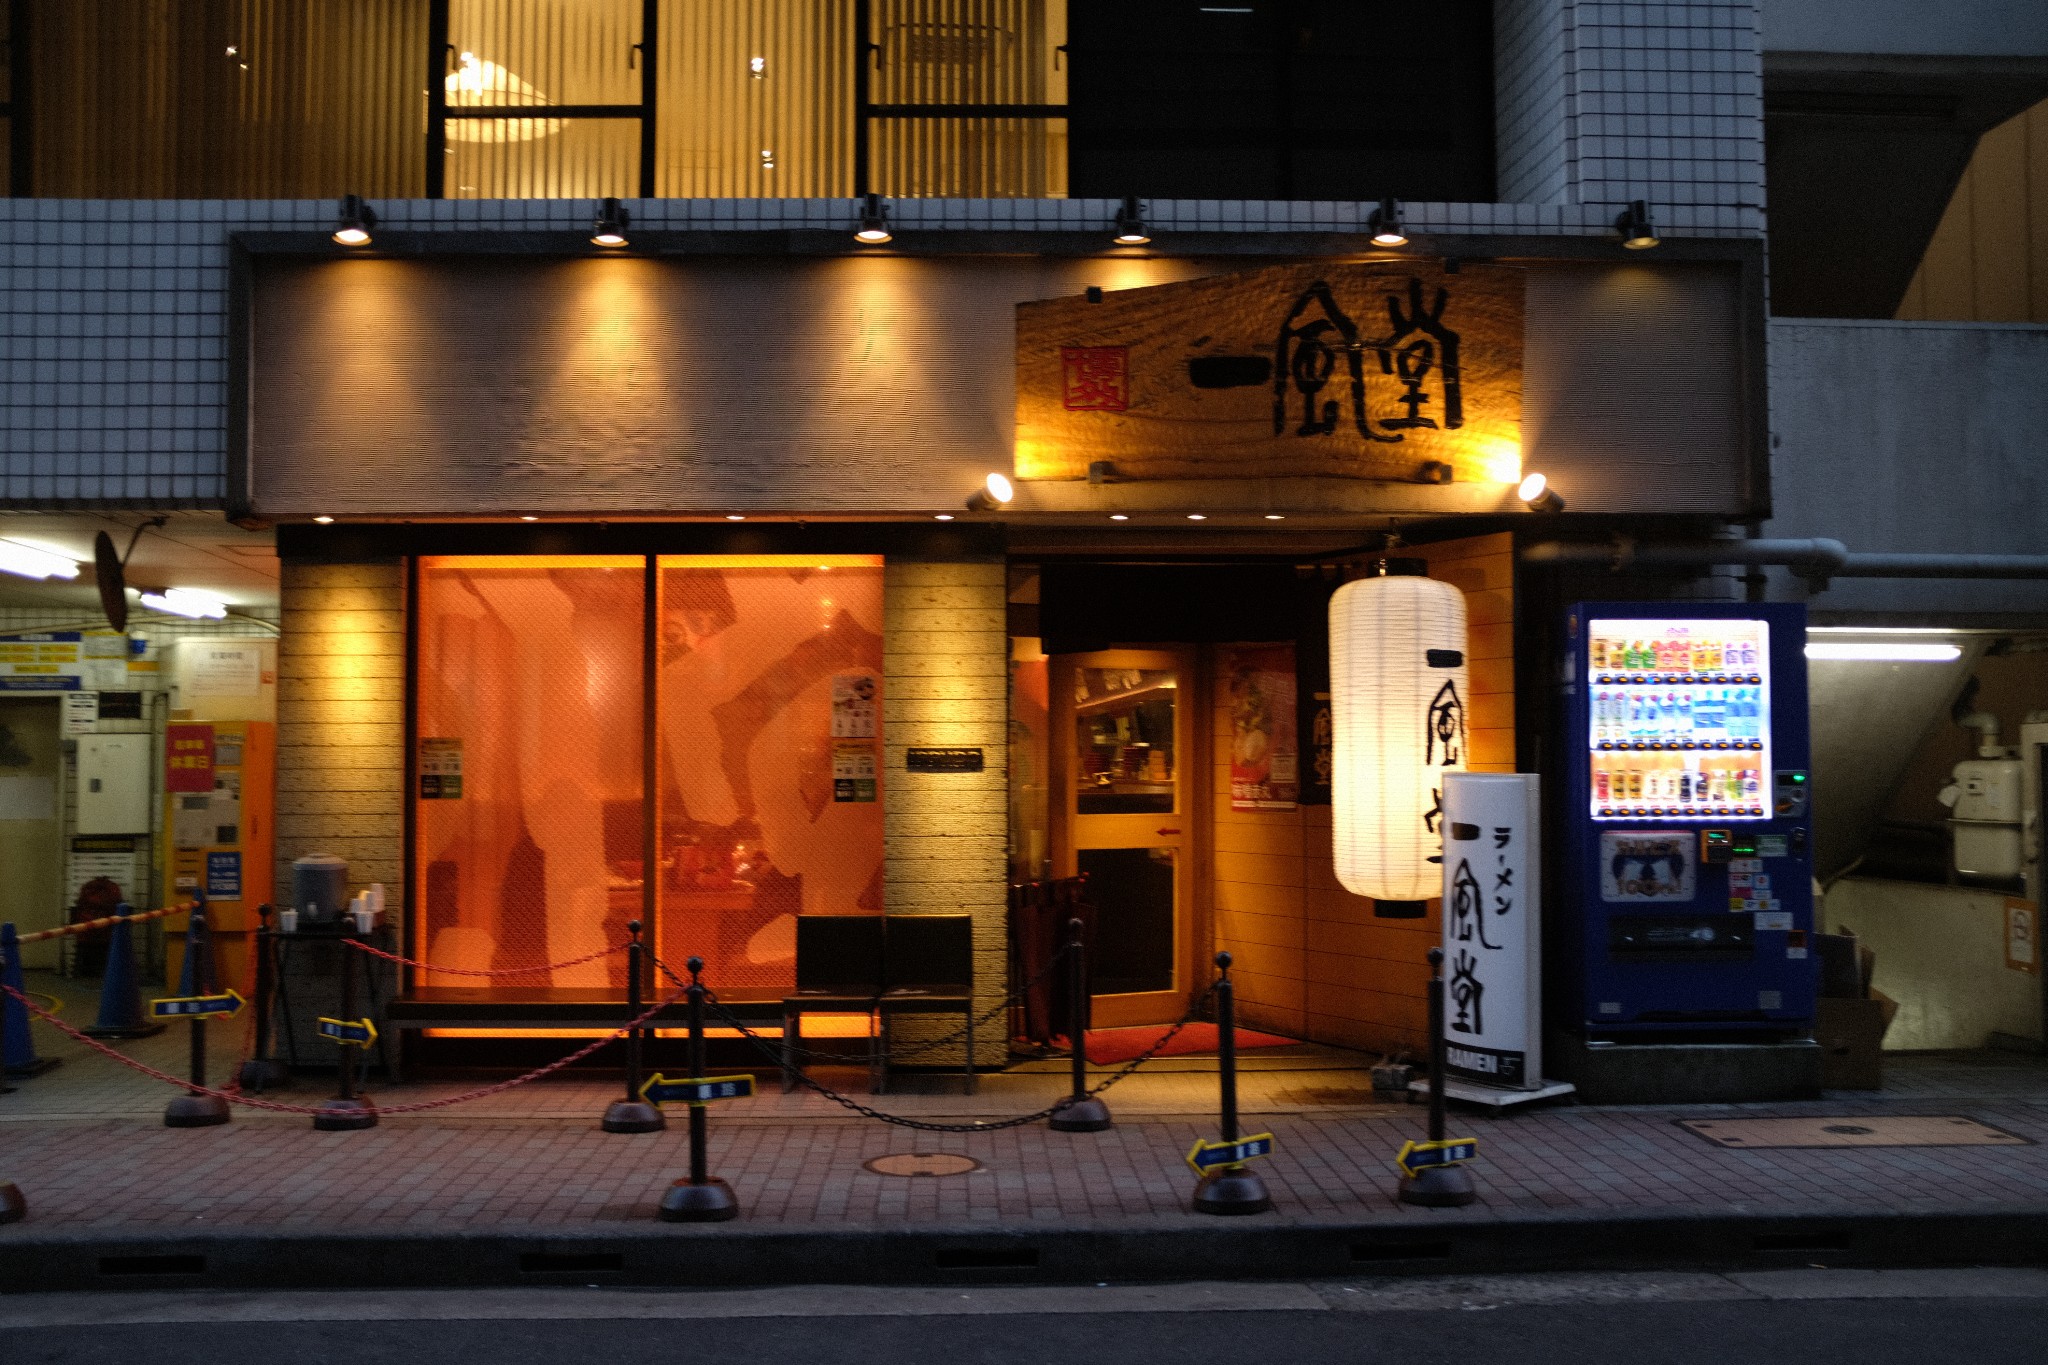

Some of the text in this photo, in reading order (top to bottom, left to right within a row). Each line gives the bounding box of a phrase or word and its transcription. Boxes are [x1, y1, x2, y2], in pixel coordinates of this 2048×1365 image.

[1189, 277, 1463, 443] 一風堂
[1451, 822, 1503, 1034] 一風堂
[1494, 826, 1514, 916] ラーメン
[1446, 1046, 1498, 1074] RAMEN
